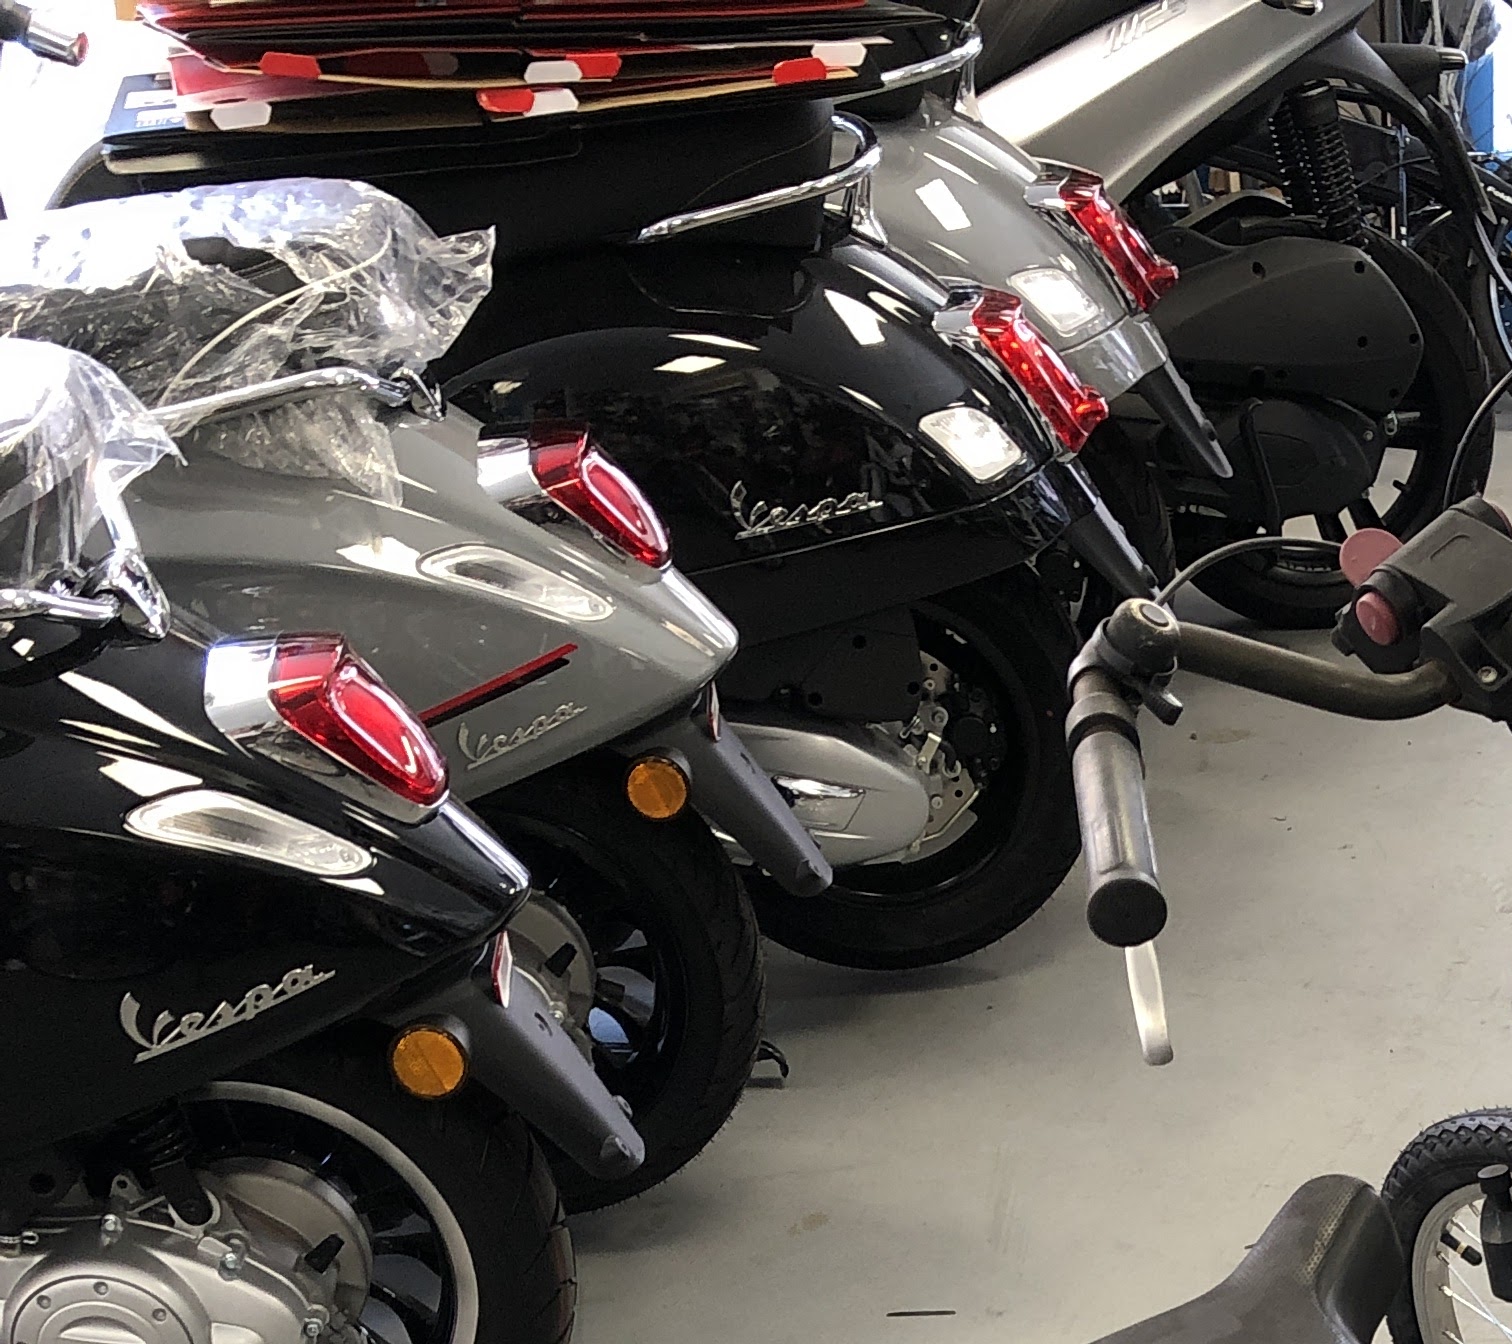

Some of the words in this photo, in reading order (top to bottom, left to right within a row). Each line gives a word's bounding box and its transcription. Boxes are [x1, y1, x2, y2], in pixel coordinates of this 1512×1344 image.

[729, 479, 884, 541] Vespa
[458, 701, 588, 770] Vespa
[119, 963, 337, 1064] Vespa
